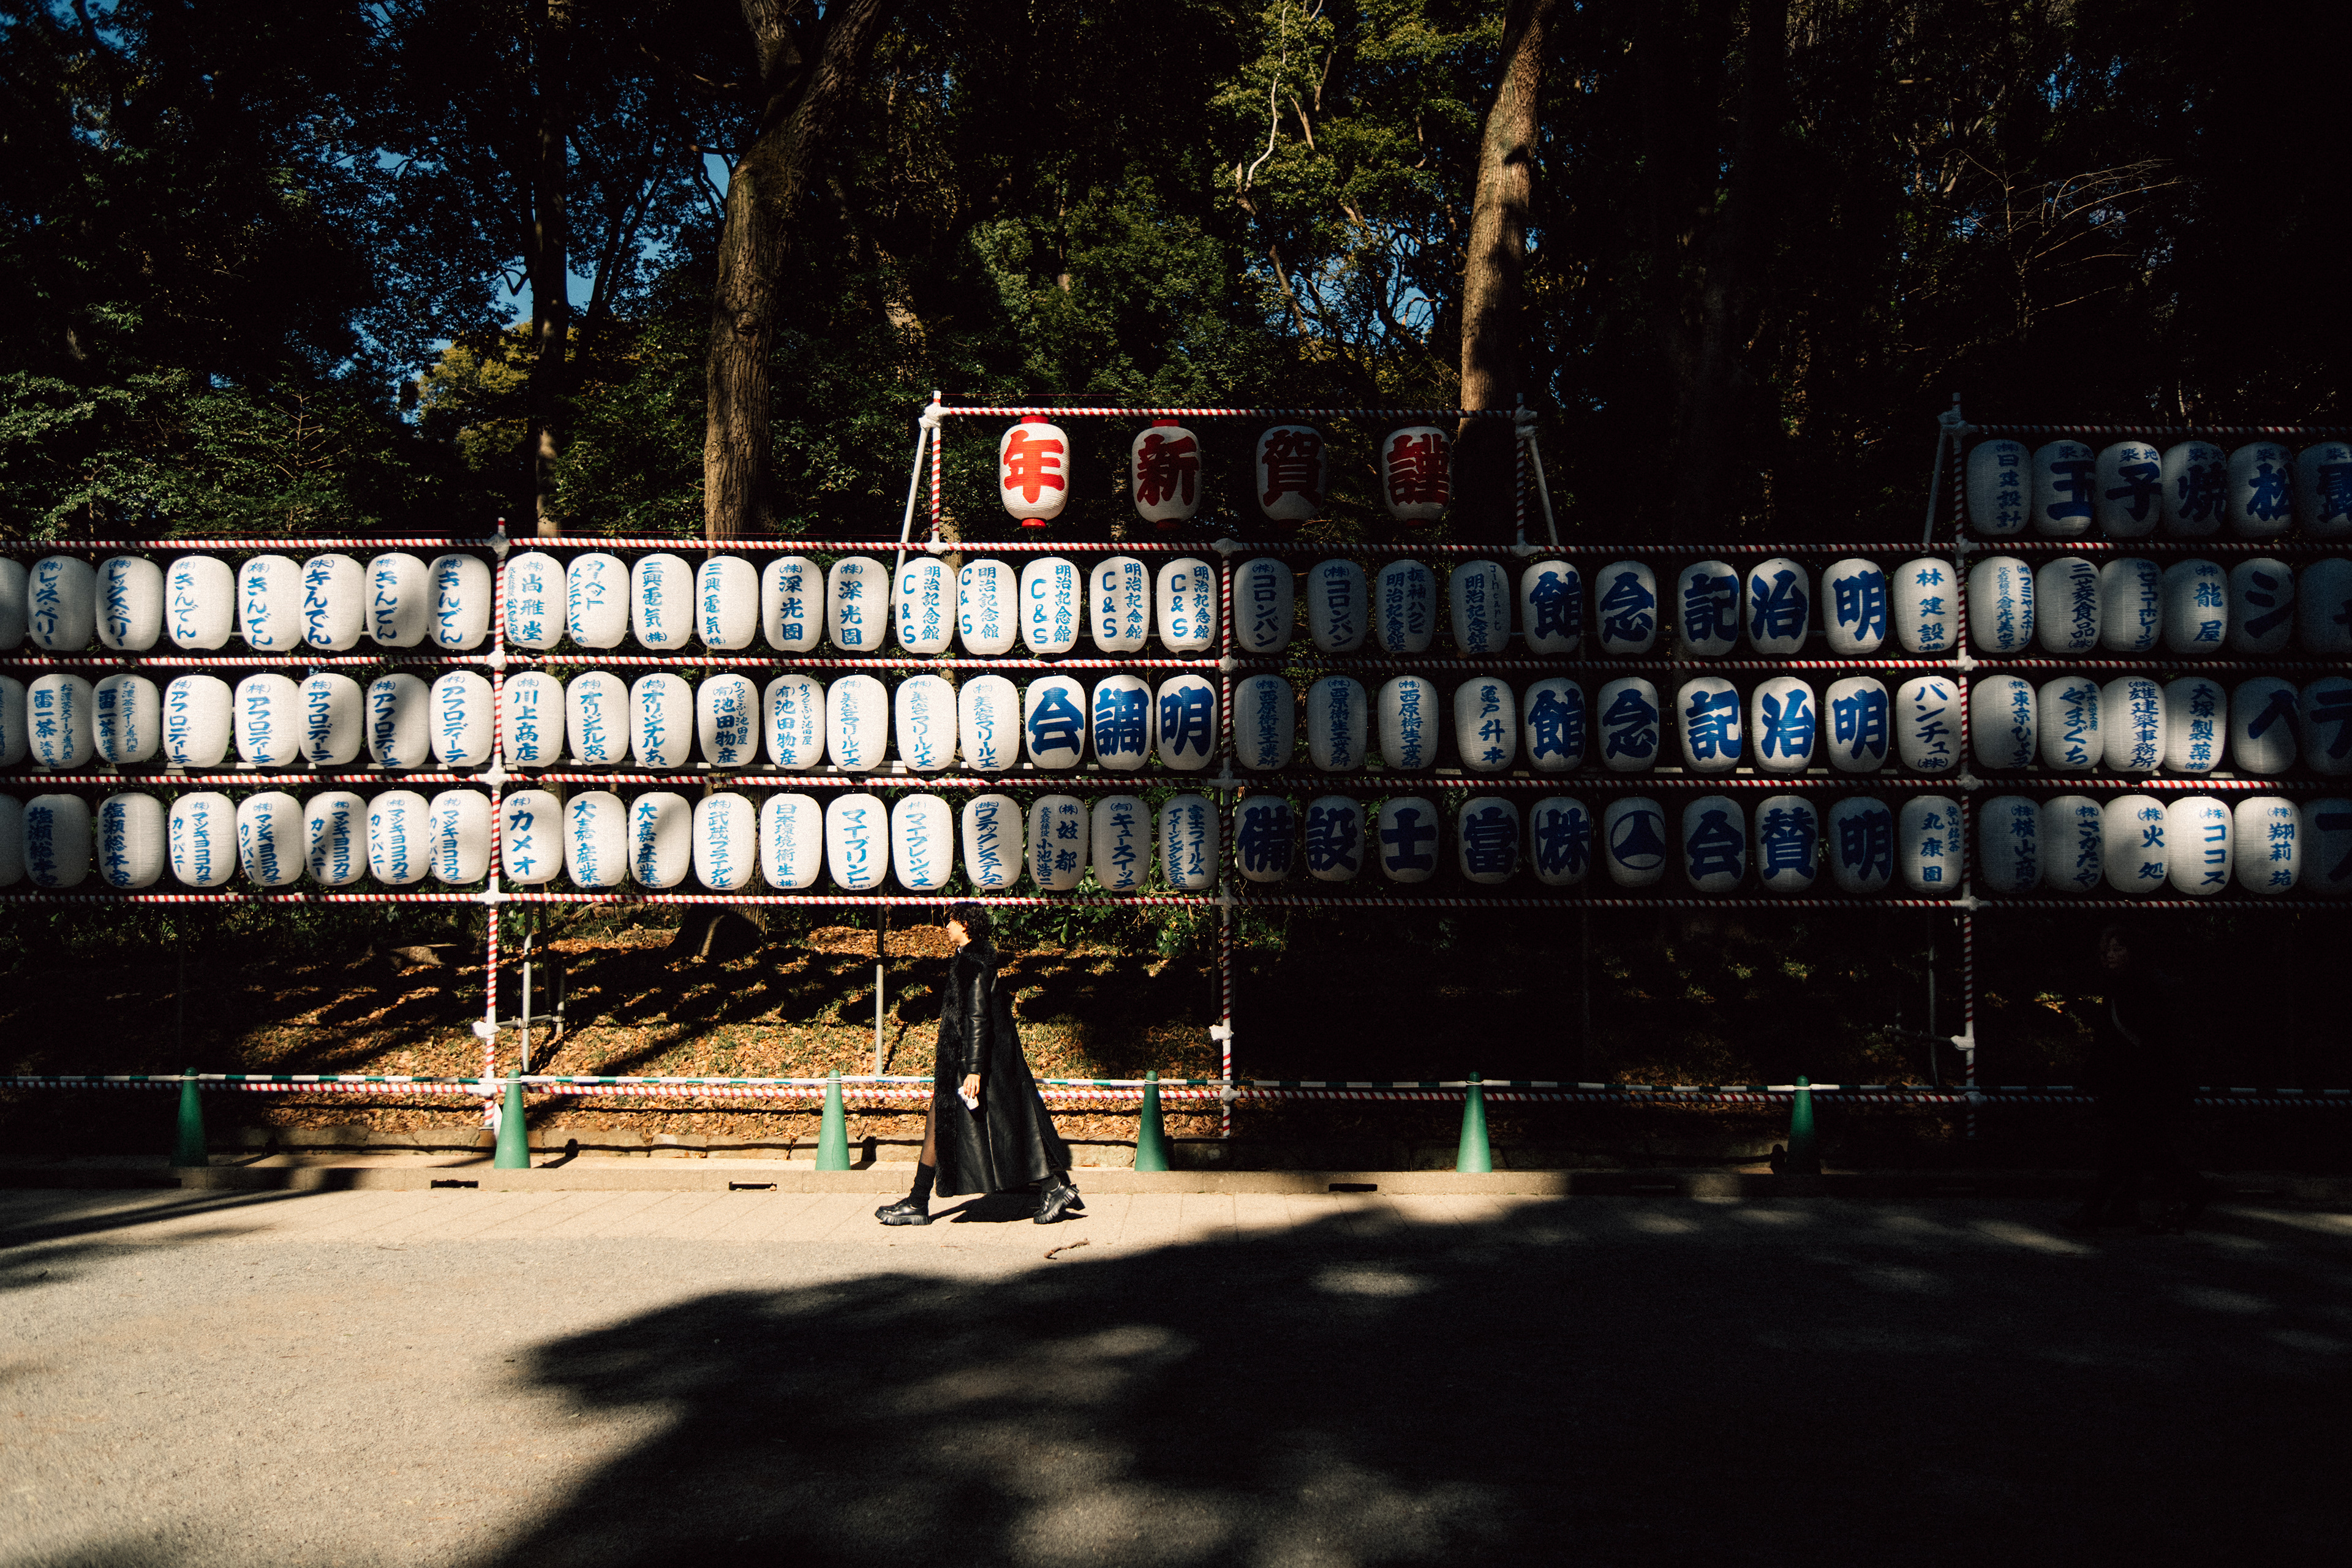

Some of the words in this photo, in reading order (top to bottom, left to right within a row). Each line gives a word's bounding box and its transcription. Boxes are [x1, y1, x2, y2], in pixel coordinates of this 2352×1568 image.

[1004, 429, 1064, 504] 年
[1137, 433, 1200, 506] 新
[1261, 429, 1322, 507] 賀
[1387, 433, 1451, 505] 謹
[2105, 462, 2161, 522] 子
[2178, 462, 2227, 523] 焼
[175, 562, 198, 639] (株)きんでん
[247, 563, 273, 646] (株)きんでん
[304, 559, 334, 645] (株)きんでん
[375, 559, 398, 639] (株)きんでん
[438, 559, 462, 644] (株)きんでん
[521, 561, 545, 641] (株)尚雅堂
[585, 560, 606, 611] カーペット
[643, 562, 667, 643] 三興電気(株)
[704, 563, 725, 646] 三興電気(株)
[779, 564, 804, 641] (株)深光園
[839, 564, 863, 646] (株)深光園
[922, 566, 941, 640] 明治記念館
[978, 567, 999, 639] 明治記念館
[1054, 565, 1072, 643] 明治記念館
[1124, 563, 1142, 639] 明治記念館
[1193, 566, 1210, 639] 明治記念館
[1252, 564, 1280, 647] (株)コロンバン
[1324, 566, 1352, 647] (株)コロンバン
[1407, 568, 1427, 633] 振袖ハクビ
[1529, 571, 1581, 639] 館
[1600, 571, 1654, 643] 念
[1684, 573, 1739, 643] 記
[1751, 570, 1807, 640] 治
[1832, 570, 1886, 641] 明
[1916, 568, 1945, 652] 林建設(株)
[2069, 564, 2096, 649] 三菱食品(株)
[2193, 565, 2223, 643] (株)龍屋
[168, 680, 191, 764] (株)アフロディーテ
[246, 683, 275, 764] (株)アフロディーテ
[308, 680, 333, 761] (株)アフロディーテ
[372, 681, 402, 767] (株)アフロディーテ
[442, 676, 467, 762] (株)アフロディーテ
[514, 679, 539, 761] (株)川上商店
[713, 686, 738, 764] (有)池田物産
[775, 686, 798, 765] (有)池田物産
[1028, 687, 1084, 756] 会
[1160, 686, 1213, 756] 明
[1479, 685, 1506, 764] 亀戸升本
[1528, 688, 1586, 760] 館
[1602, 688, 1658, 759] 念
[1686, 689, 1742, 761] 記
[1761, 688, 1815, 758] 治
[1833, 688, 1888, 760] 明
[2059, 687, 2088, 765] やまぐち
[2185, 684, 2214, 771] 大塚製薬(株)
[172, 816, 184, 873] カンパニー
[240, 823, 255, 880] カンパニー
[311, 817, 325, 876] カンパニー
[371, 813, 385, 874] カンパニー
[510, 797, 537, 876] (株)カメオ
[1187, 805, 1205, 876] 富士フイルム
[1238, 805, 1294, 872] 備
[1305, 807, 1357, 871] 設
[1381, 808, 1437, 872] 士
[1687, 810, 1744, 881] 会
[1761, 807, 1816, 880] 賛
[1838, 809, 1892, 881] 明
[1921, 813, 1945, 882] 丸康園
[2199, 807, 2226, 885] (株)ココス
